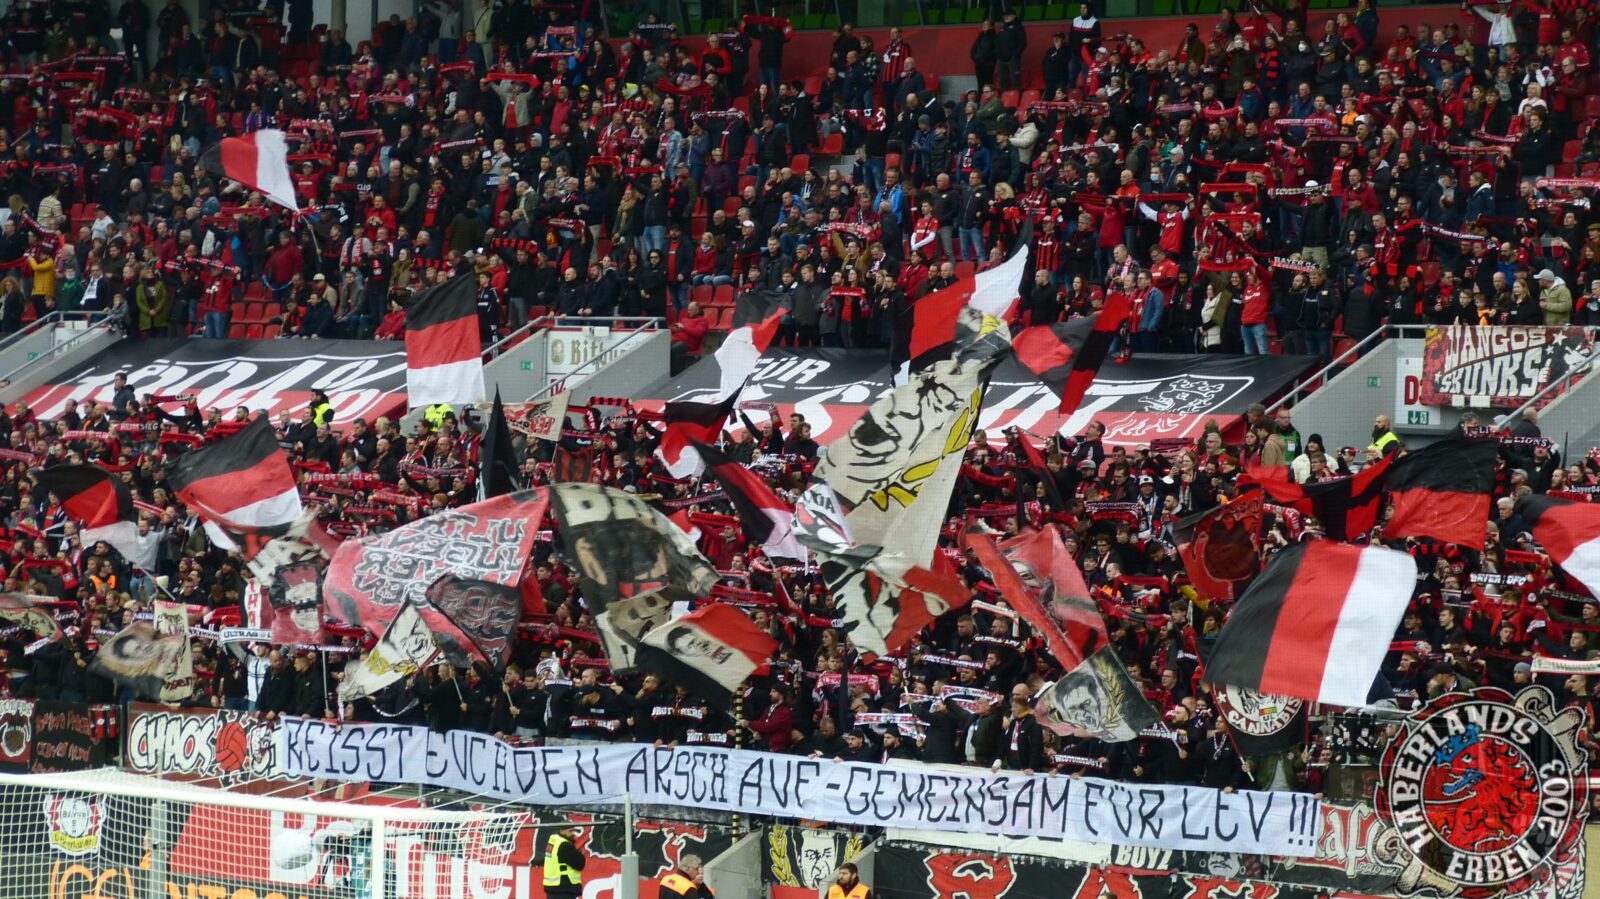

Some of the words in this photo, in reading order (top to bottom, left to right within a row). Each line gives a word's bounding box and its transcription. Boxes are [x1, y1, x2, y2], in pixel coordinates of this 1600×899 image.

[1439, 347, 1542, 397] SKUNKS
[1513, 436, 1548, 448] LIONS
[1228, 697, 1302, 734] CANNABIS
[129, 713, 217, 777] CHAOS
[284, 718, 414, 781] REISST
[513, 748, 604, 799] DEN
[625, 747, 729, 804] ARSCH
[1084, 781, 1165, 840] FÜR
[1181, 788, 1275, 843] LEV
